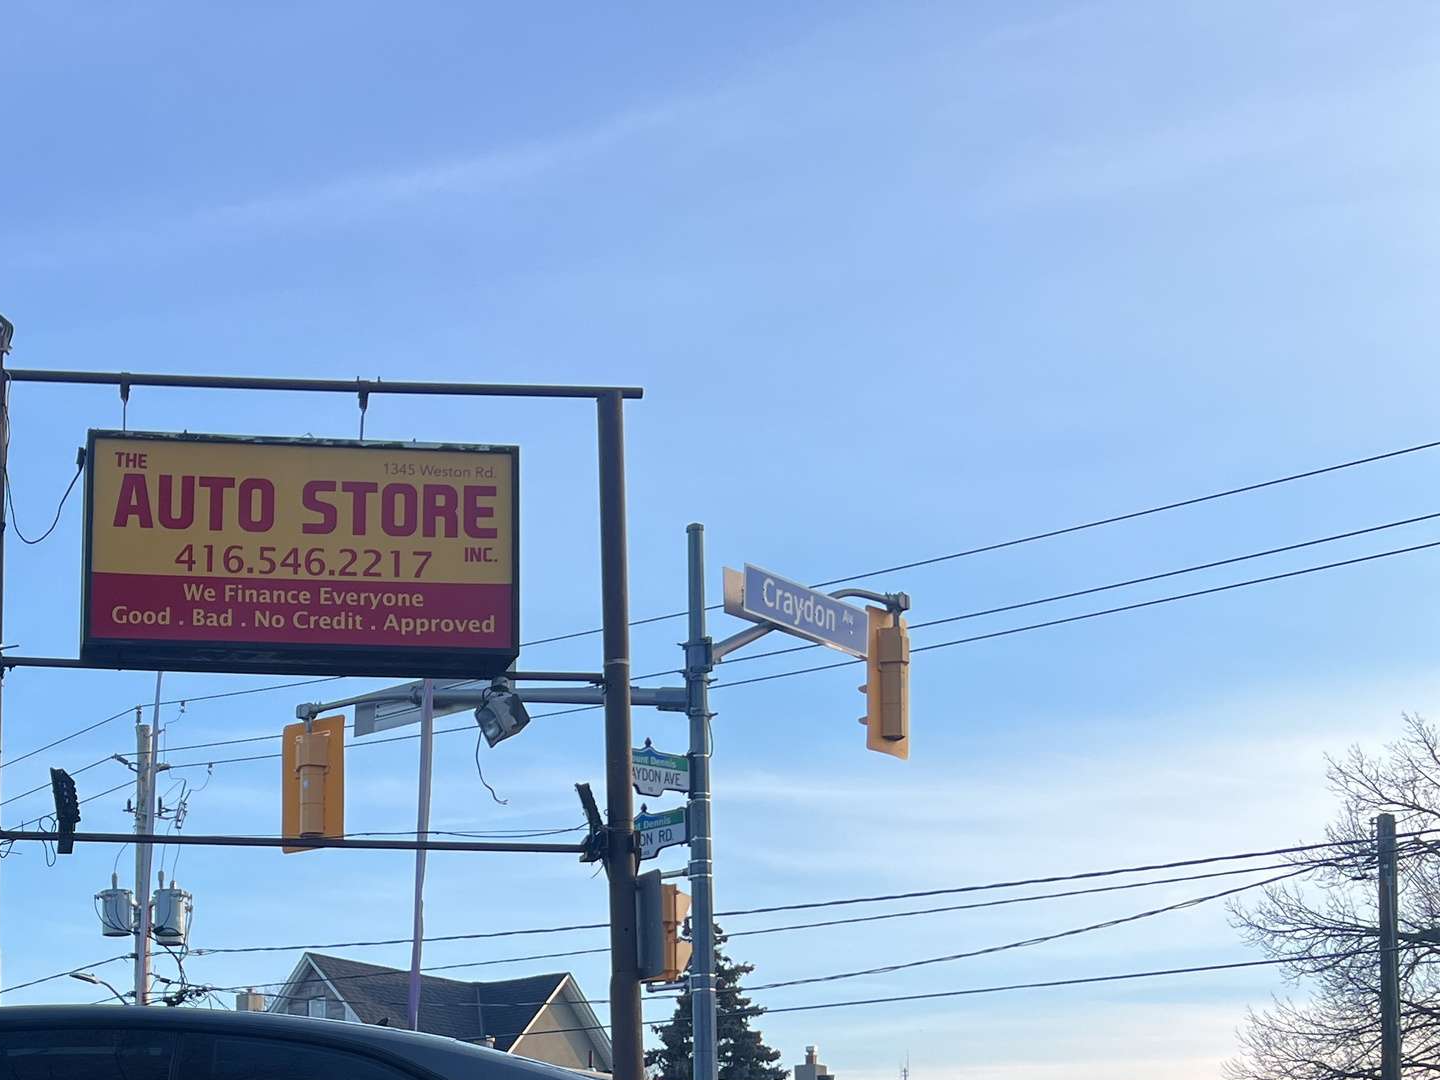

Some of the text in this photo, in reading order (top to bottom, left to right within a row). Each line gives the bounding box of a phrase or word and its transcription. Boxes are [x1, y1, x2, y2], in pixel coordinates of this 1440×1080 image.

[115, 451, 148, 469] THE
[383, 463, 496, 479] 1345 Weston Rd.
[113, 473, 498, 539] AUTO STORE
[174, 543, 433, 578] 416.546.2217
[464, 547, 498, 563] INC.
[183, 583, 424, 610] We Finance Everyone
[762, 577, 836, 632] Craydon
[111, 605, 496, 635] Good Bad No Credit Approved
